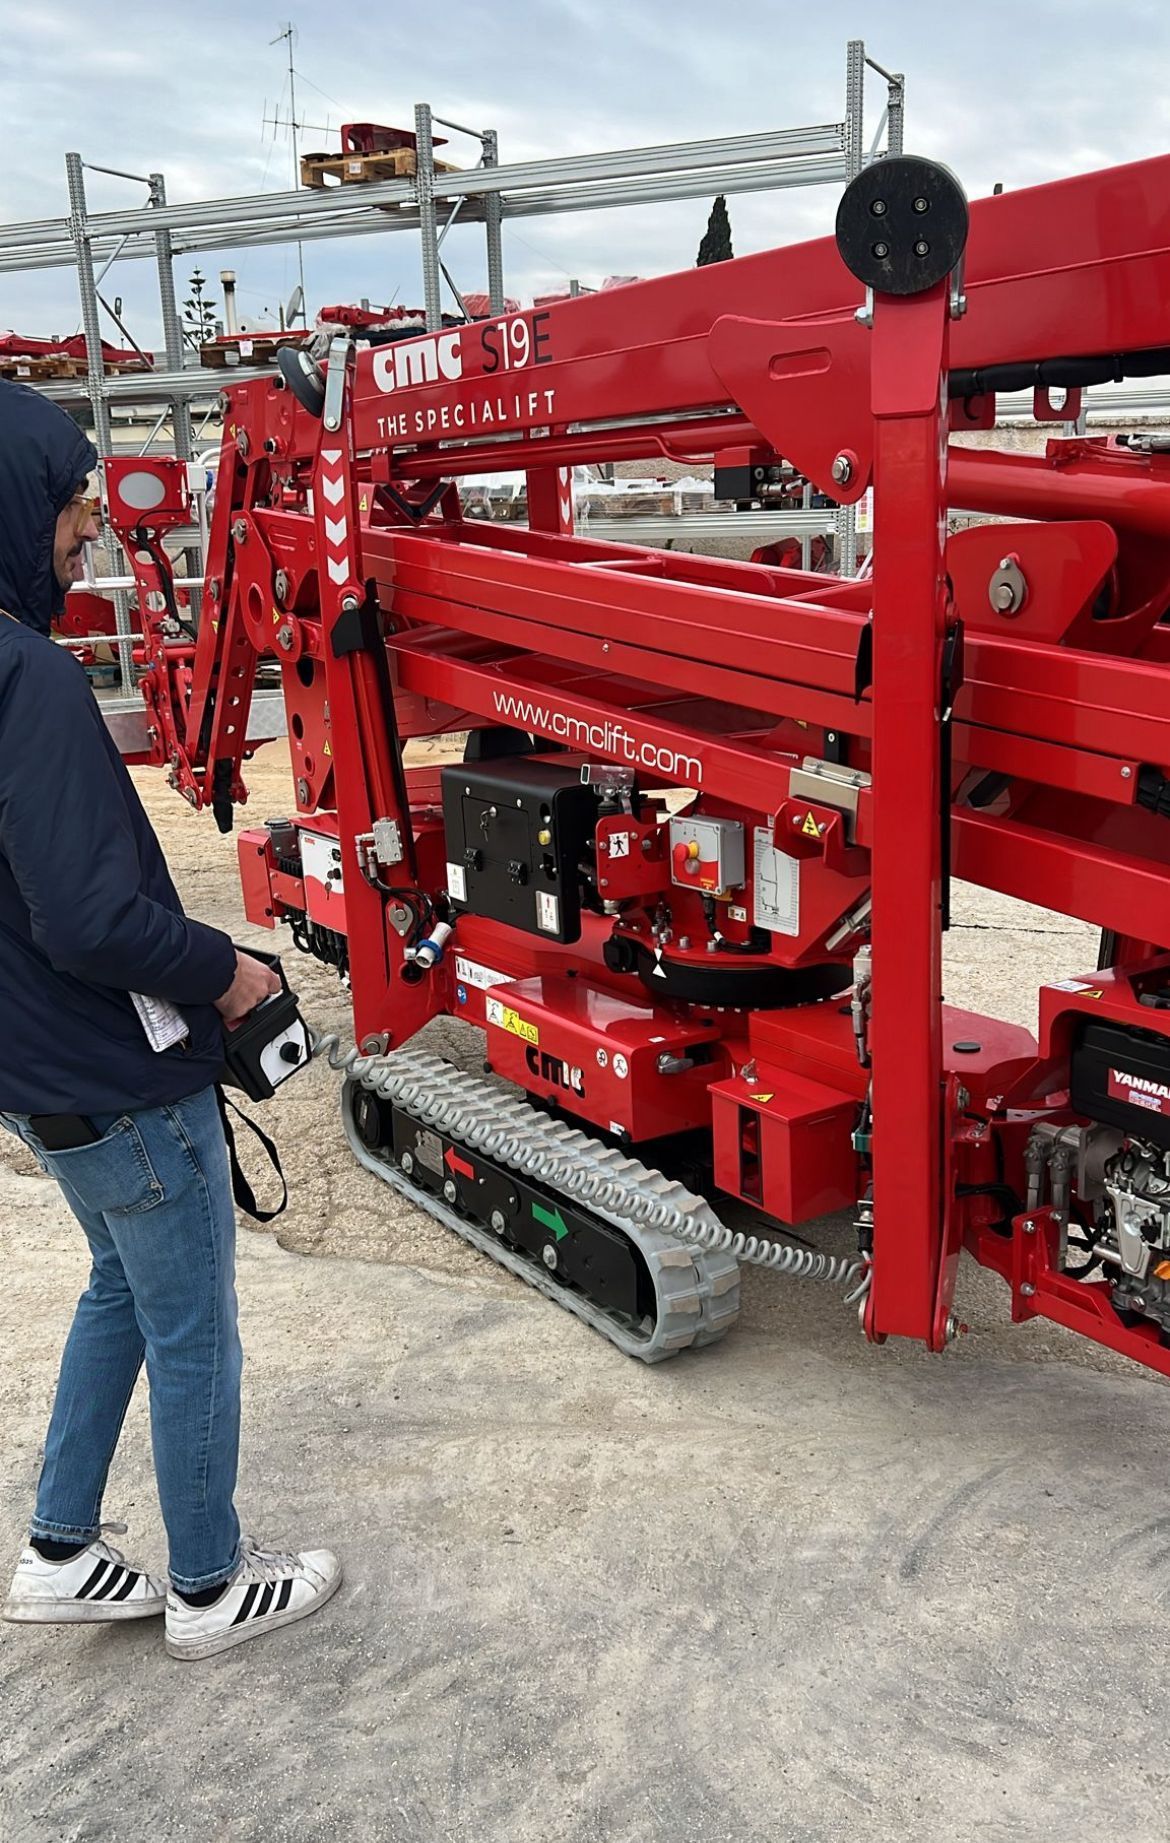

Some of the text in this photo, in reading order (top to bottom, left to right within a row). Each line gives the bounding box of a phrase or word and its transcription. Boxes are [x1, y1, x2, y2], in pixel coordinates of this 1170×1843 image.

[482, 313, 552, 372] S19E
[378, 390, 556, 438] THE SPECIALIFT
[493, 690, 702, 783] www.cmclift.com
[1113, 1070, 1170, 1099] YANMA
